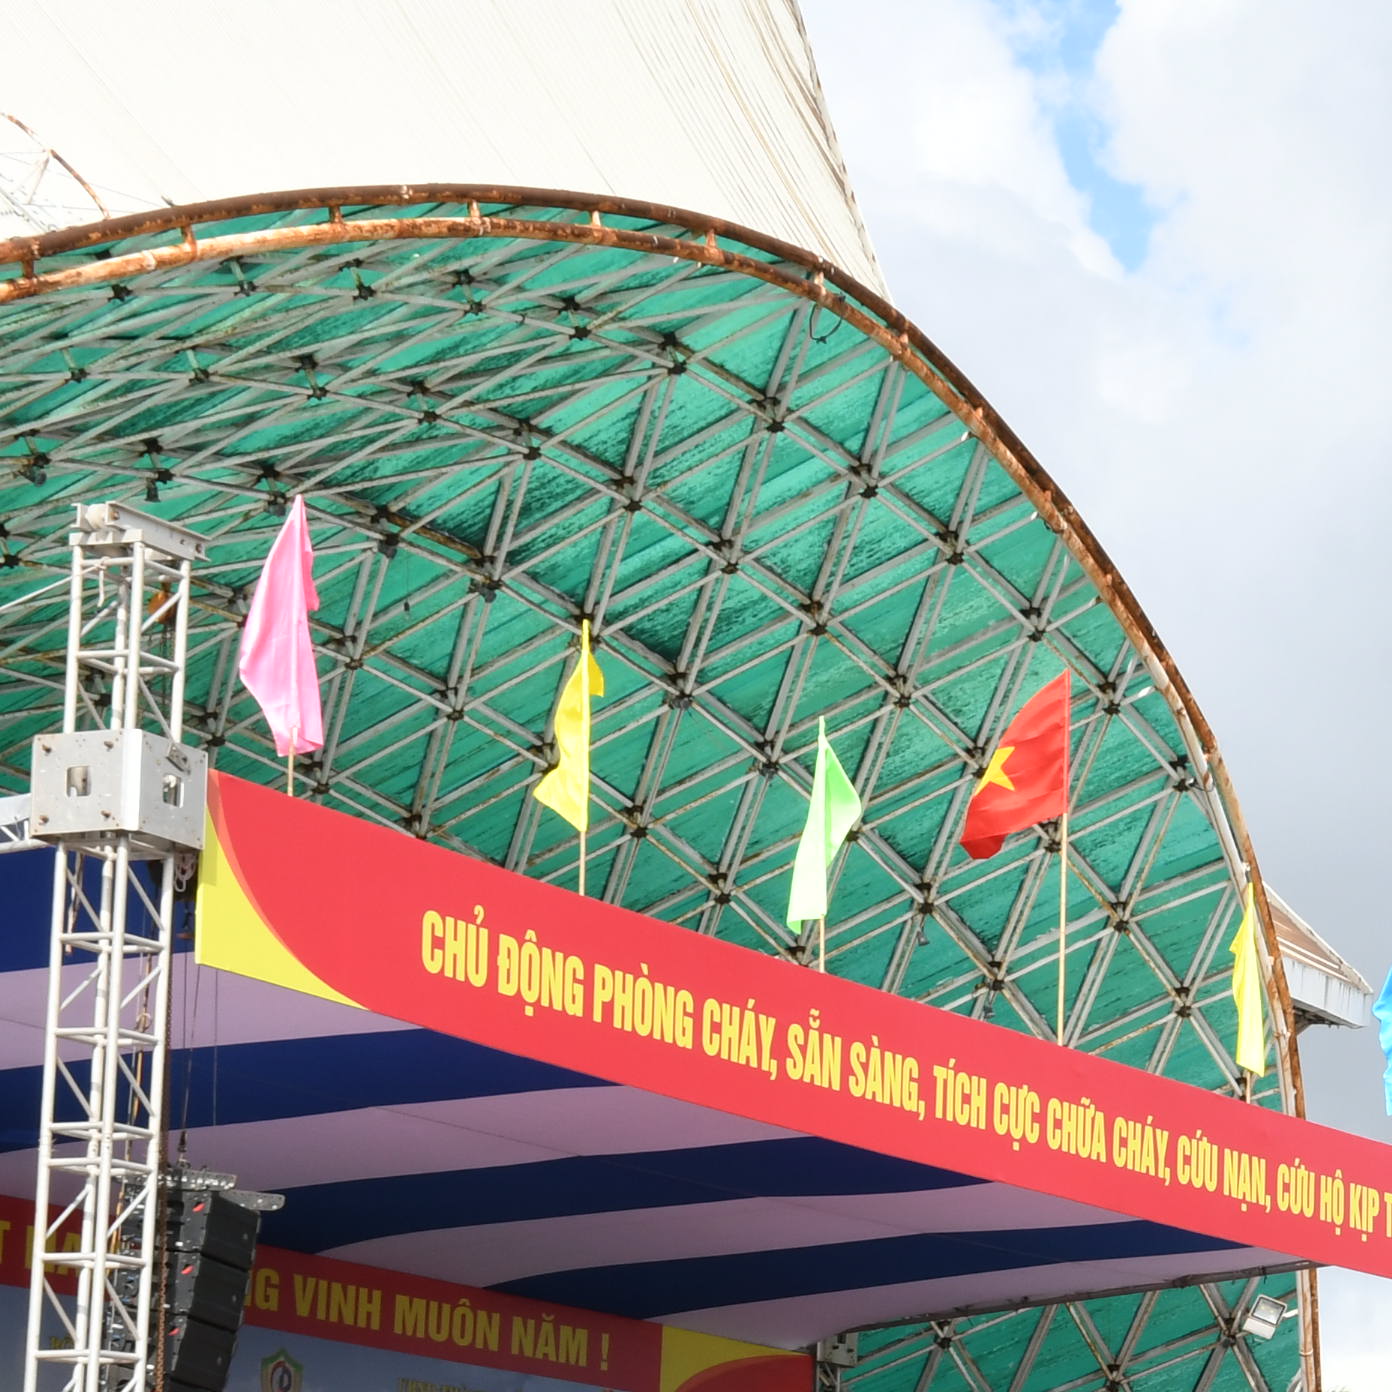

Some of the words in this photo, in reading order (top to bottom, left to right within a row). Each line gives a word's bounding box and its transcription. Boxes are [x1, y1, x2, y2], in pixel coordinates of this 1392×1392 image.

[421, 904, 489, 988] CHỦ
[496, 929, 585, 1017] ĐỘNG
[592, 962, 694, 1050] PHÒNG
[701, 998, 778, 1081] CHÁY,
[785, 1008, 842, 1092] SẴN
[848, 1035, 926, 1121] SÀNG,
[932, 1057, 987, 1130] TÍCH
[993, 1082, 1041, 1152] CỰC
[1046, 1097, 1107, 1163] CHỮA
[1112, 1115, 1171, 1187] CHÁY,
[1176, 1129, 1219, 1193] CỨU
[1222, 1148, 1271, 1213] NẠN,
[1276, 1157, 1316, 1218] CỨU
[1319, 1168, 1345, 1236] HỘ
[1349, 1182, 1380, 1242] KỊP
[293, 1273, 383, 1331] VINH
[393, 1293, 501, 1352] MUÔN
[511, 1312, 590, 1367] NĂM
[600, 1333, 610, 1371] !
